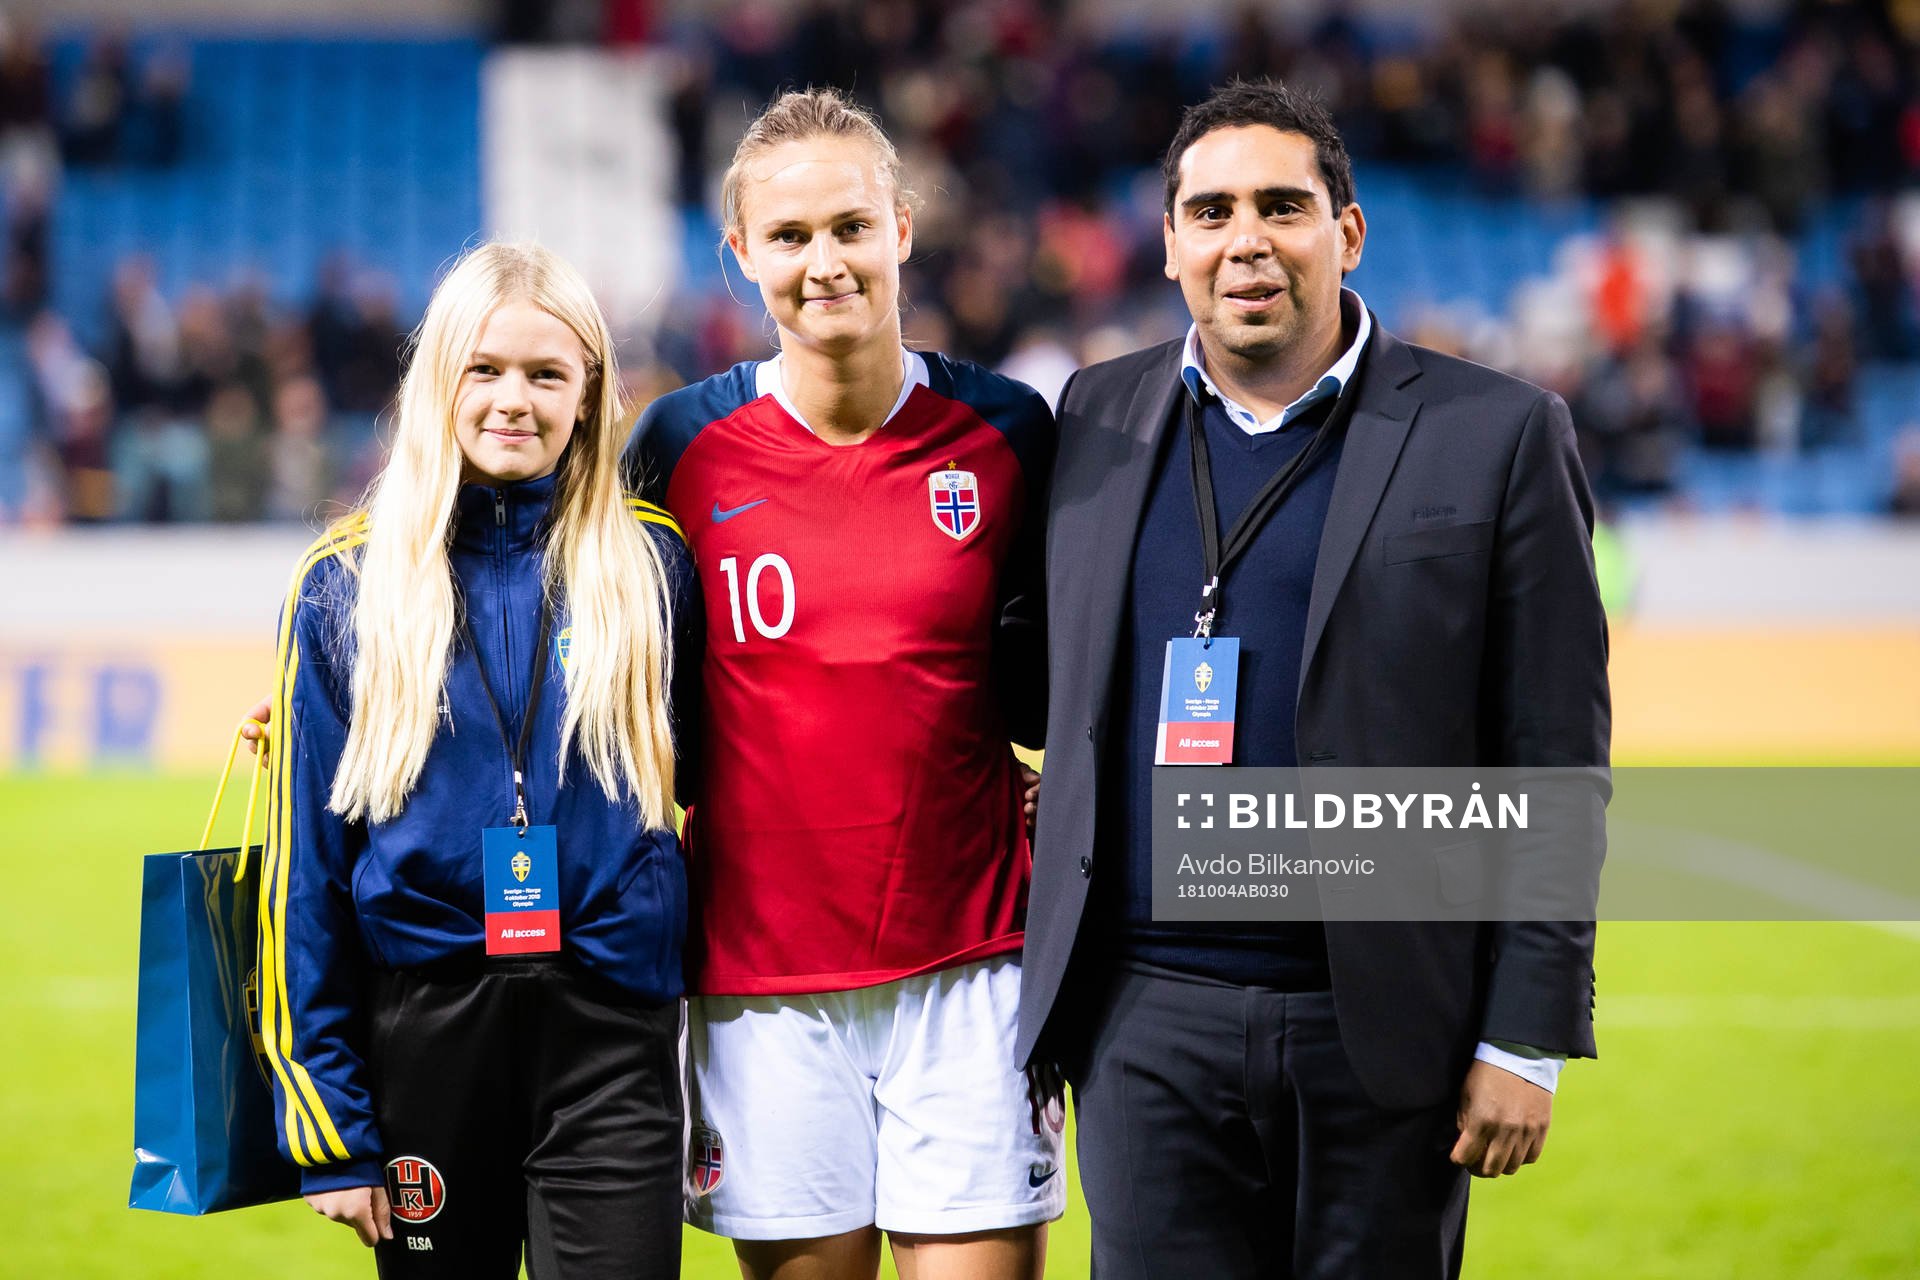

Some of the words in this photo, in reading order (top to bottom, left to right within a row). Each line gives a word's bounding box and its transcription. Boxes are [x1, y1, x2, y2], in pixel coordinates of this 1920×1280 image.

[719, 553, 796, 643] 10
[1178, 738, 1191, 748] All
[1191, 739, 1220, 748] access
[501, 929, 514, 939] All
[515, 929, 546, 938] access
[407, 1236, 433, 1251] ELSA
